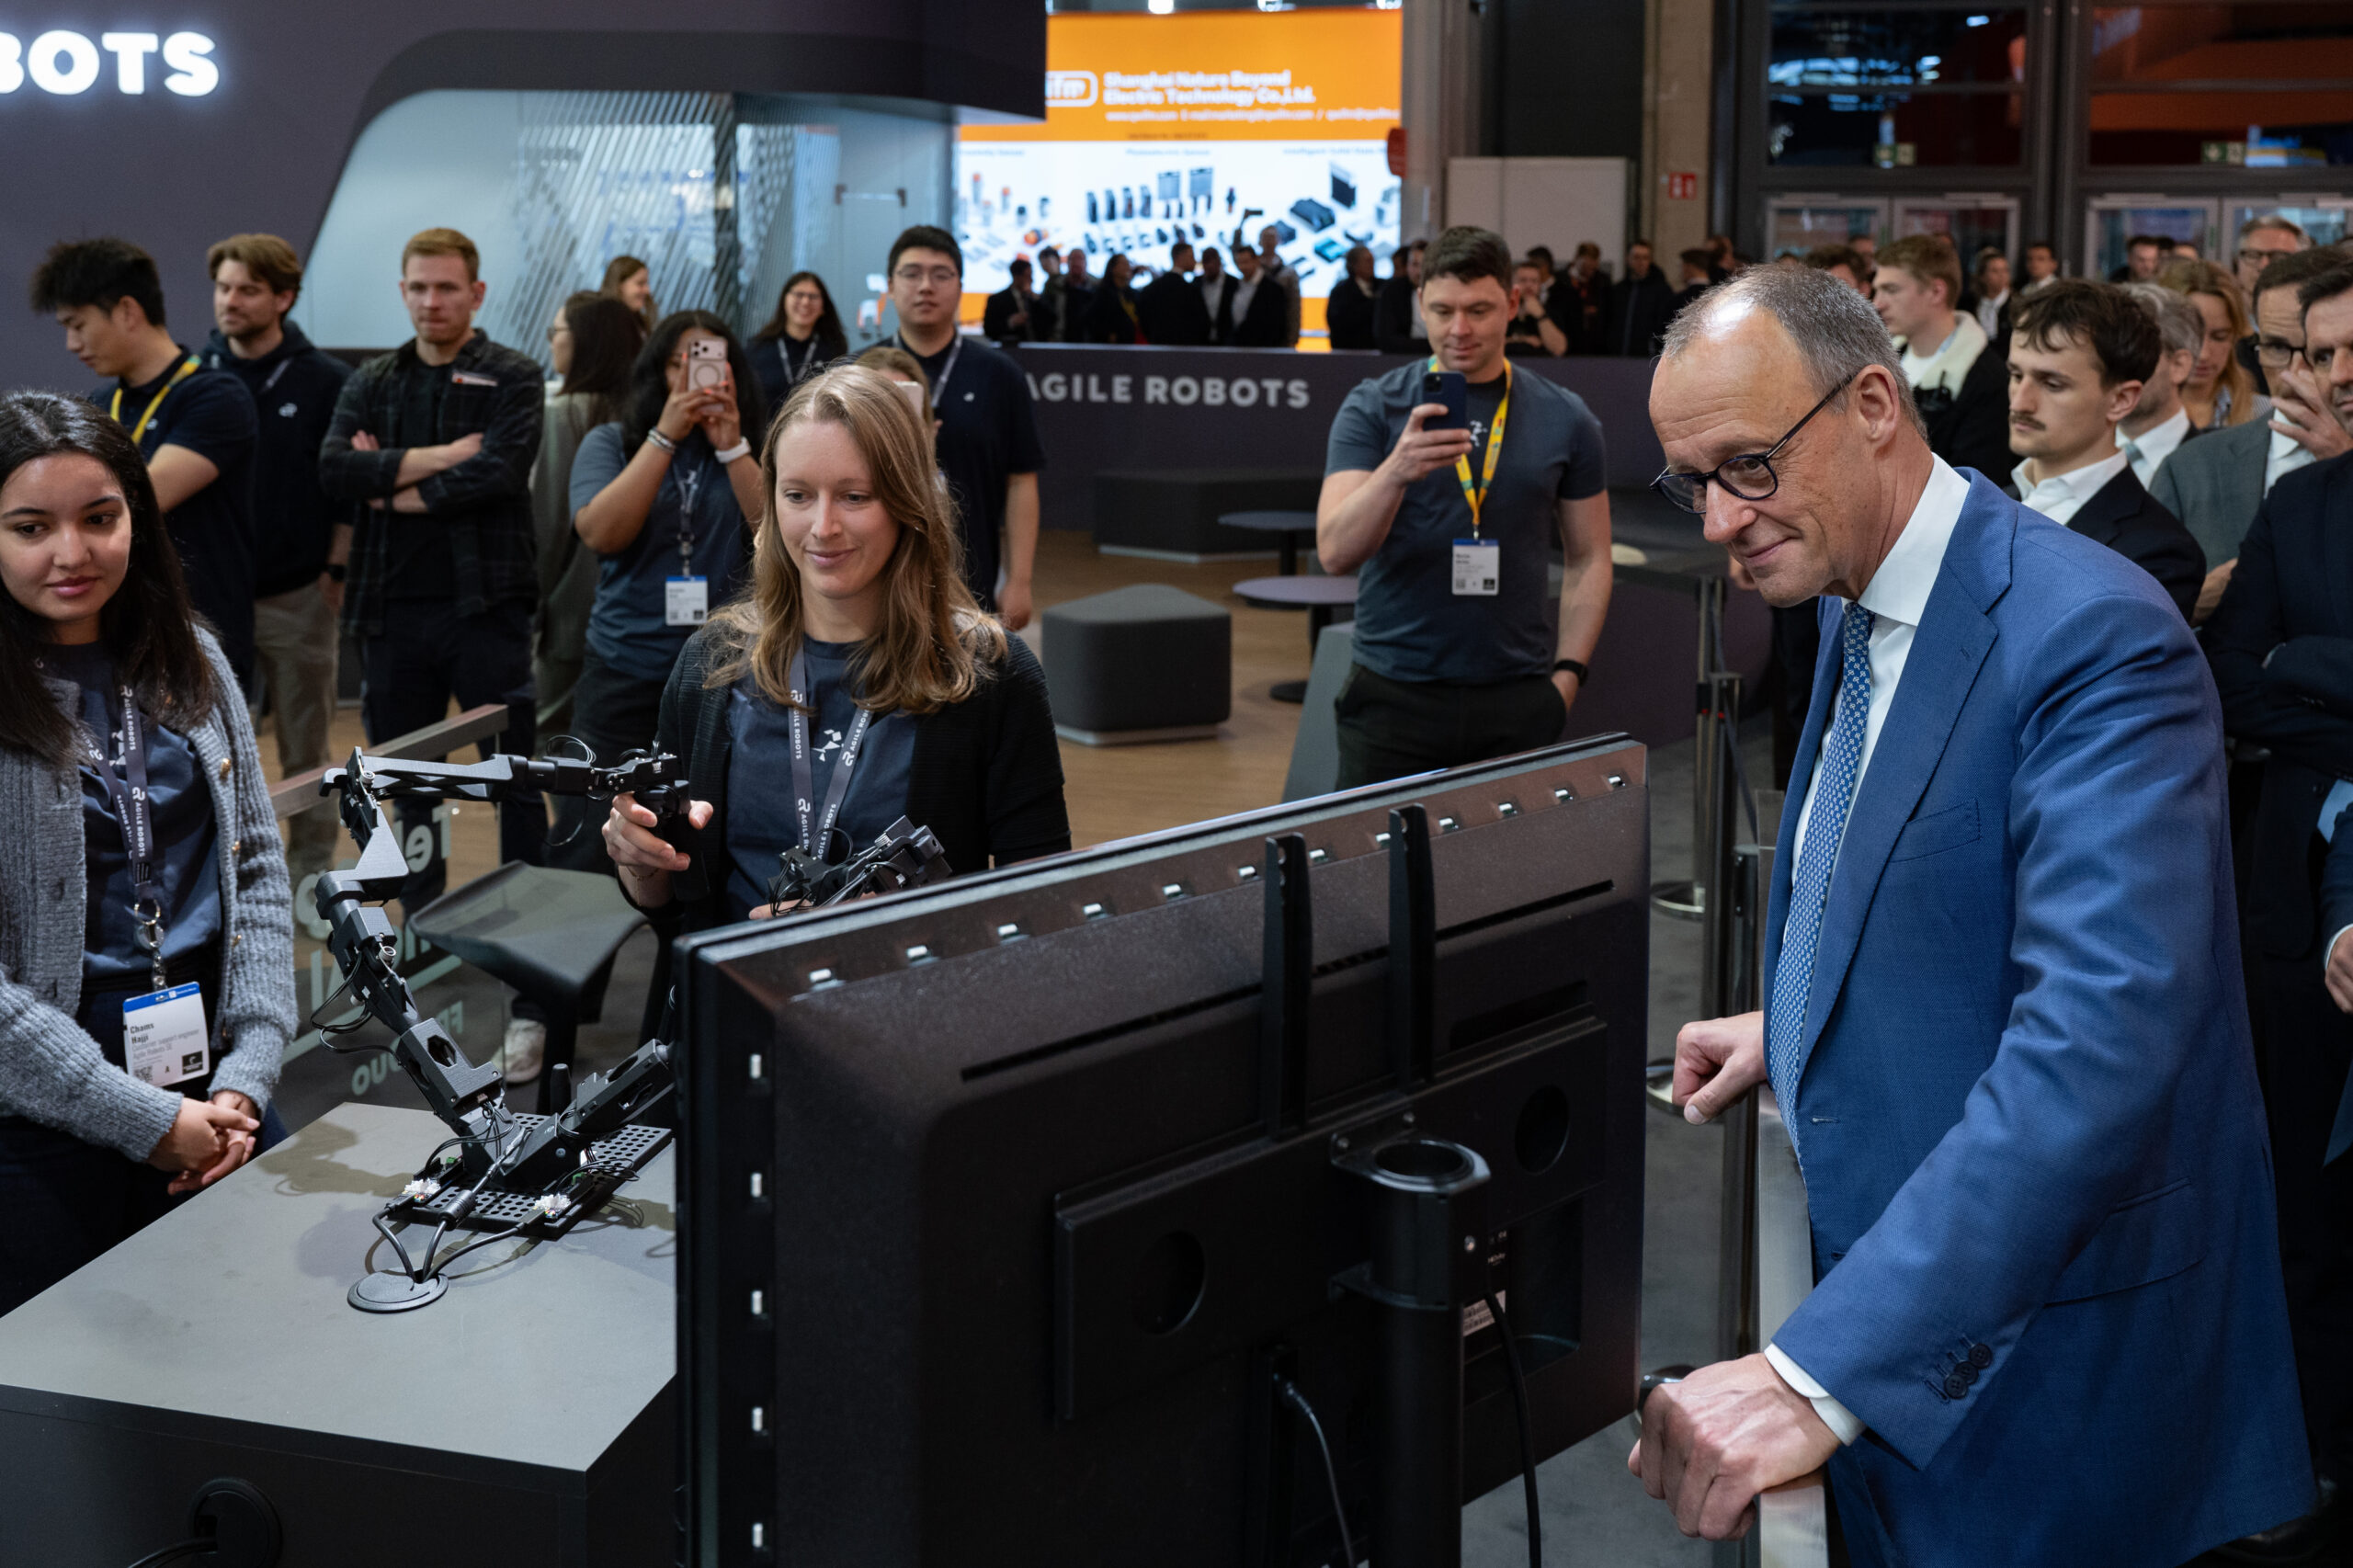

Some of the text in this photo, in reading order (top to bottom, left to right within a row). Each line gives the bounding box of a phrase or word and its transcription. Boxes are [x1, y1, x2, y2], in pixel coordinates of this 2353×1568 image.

[1144, 376, 1310, 409] ROBOTS
[128, 721, 136, 751] ROBOTS
[794, 728, 802, 759] ROBOTS
[850, 729, 861, 751] AGILE
[135, 801, 146, 858] AGILE ROBOTS
[801, 813, 809, 837] AGILE
[818, 835, 827, 860] AGILE
[130, 1023, 154, 1034] Chams
